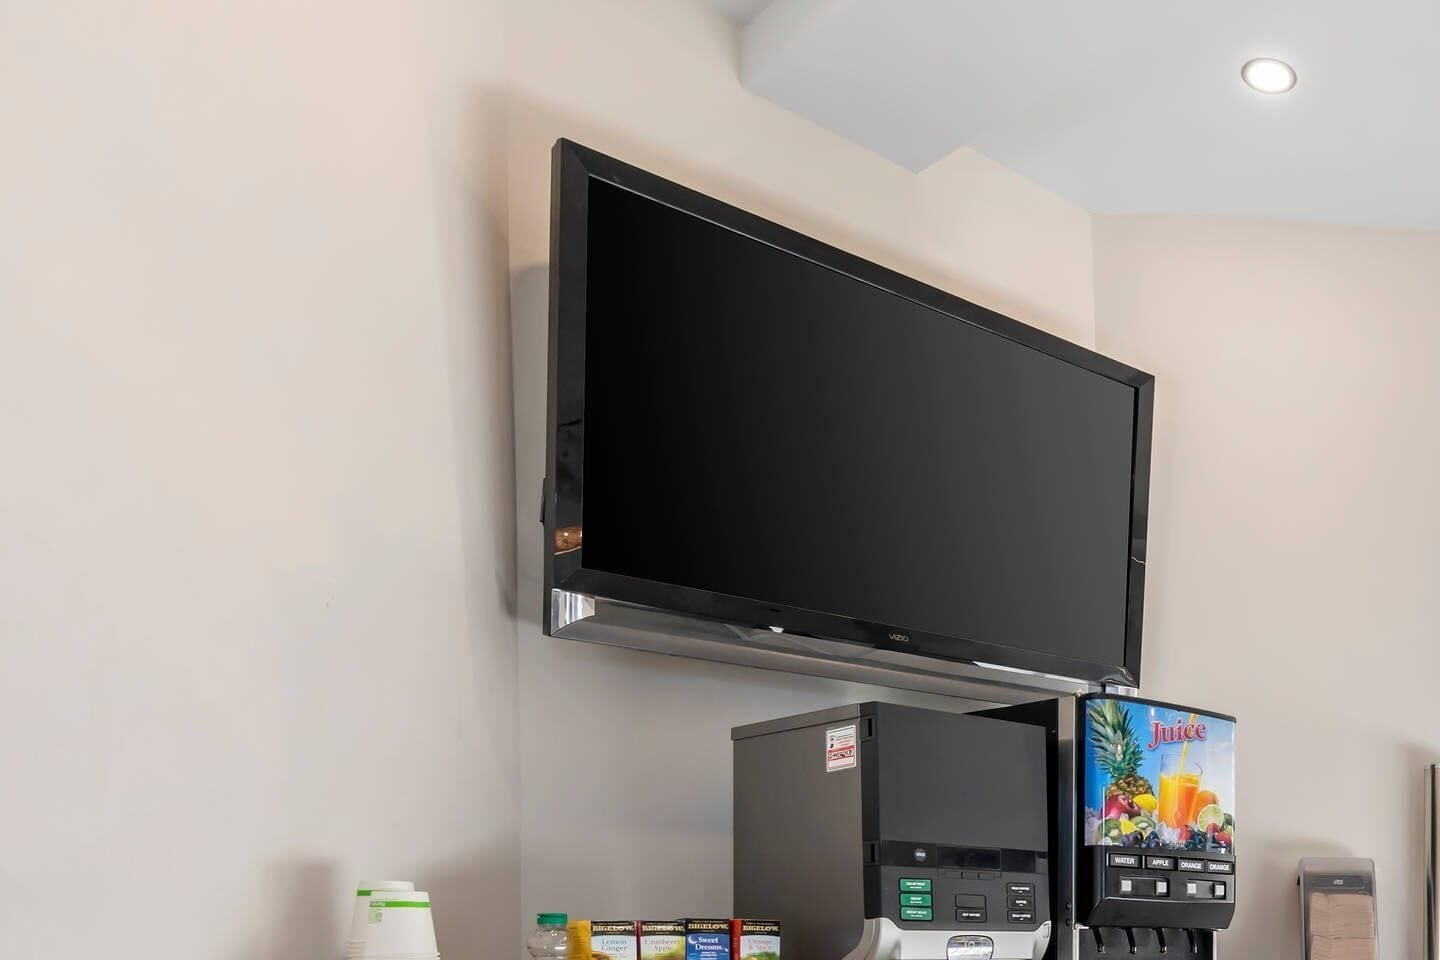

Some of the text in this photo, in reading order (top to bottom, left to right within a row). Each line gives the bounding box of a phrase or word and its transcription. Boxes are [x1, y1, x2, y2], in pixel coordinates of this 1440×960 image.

[1147, 717, 1207, 750] Juice
[1114, 856, 1135, 865] WATER
[1152, 858, 1169, 867] APPLE
[1180, 862, 1202, 870] ORANGE
[1209, 863, 1230, 871] ORANGE
[644, 938, 680, 946] Cranberry
[698, 936, 719, 944] Sweet
[695, 943, 722, 951] Dreams
